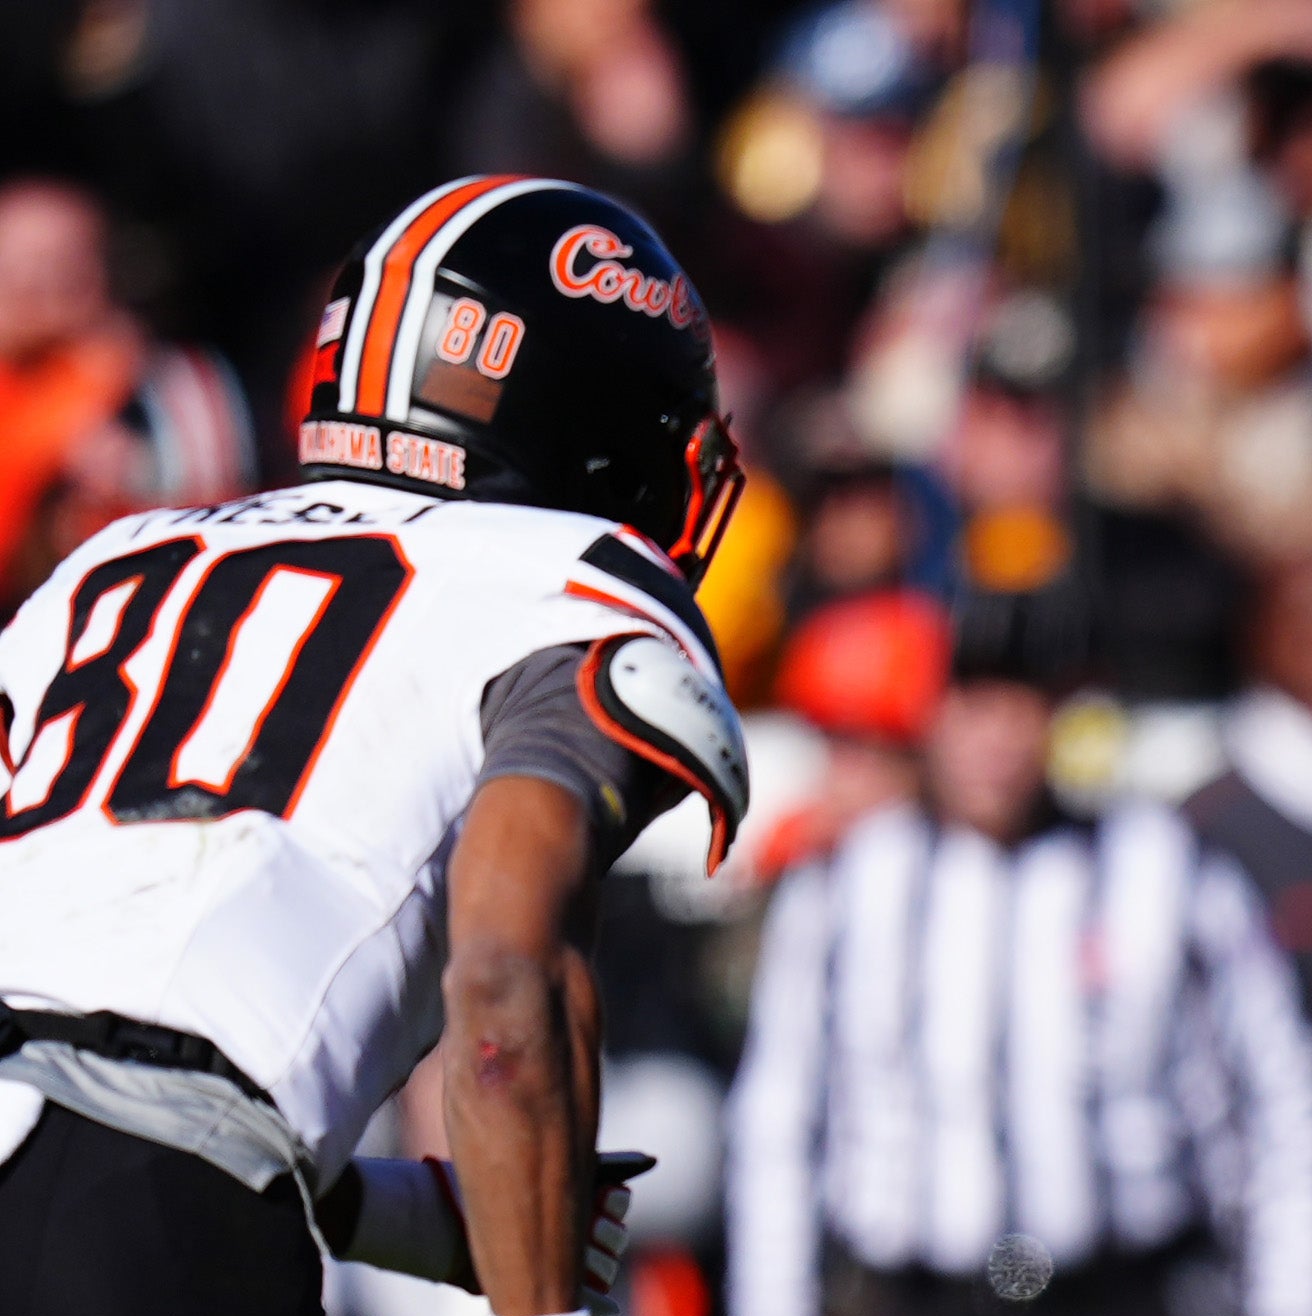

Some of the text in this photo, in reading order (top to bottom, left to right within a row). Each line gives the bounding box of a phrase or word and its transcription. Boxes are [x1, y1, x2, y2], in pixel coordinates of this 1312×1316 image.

[550, 224, 704, 329] Cowb
[434, 297, 526, 380] 80
[386, 430, 466, 490] STATE
[0, 534, 416, 843] 80
